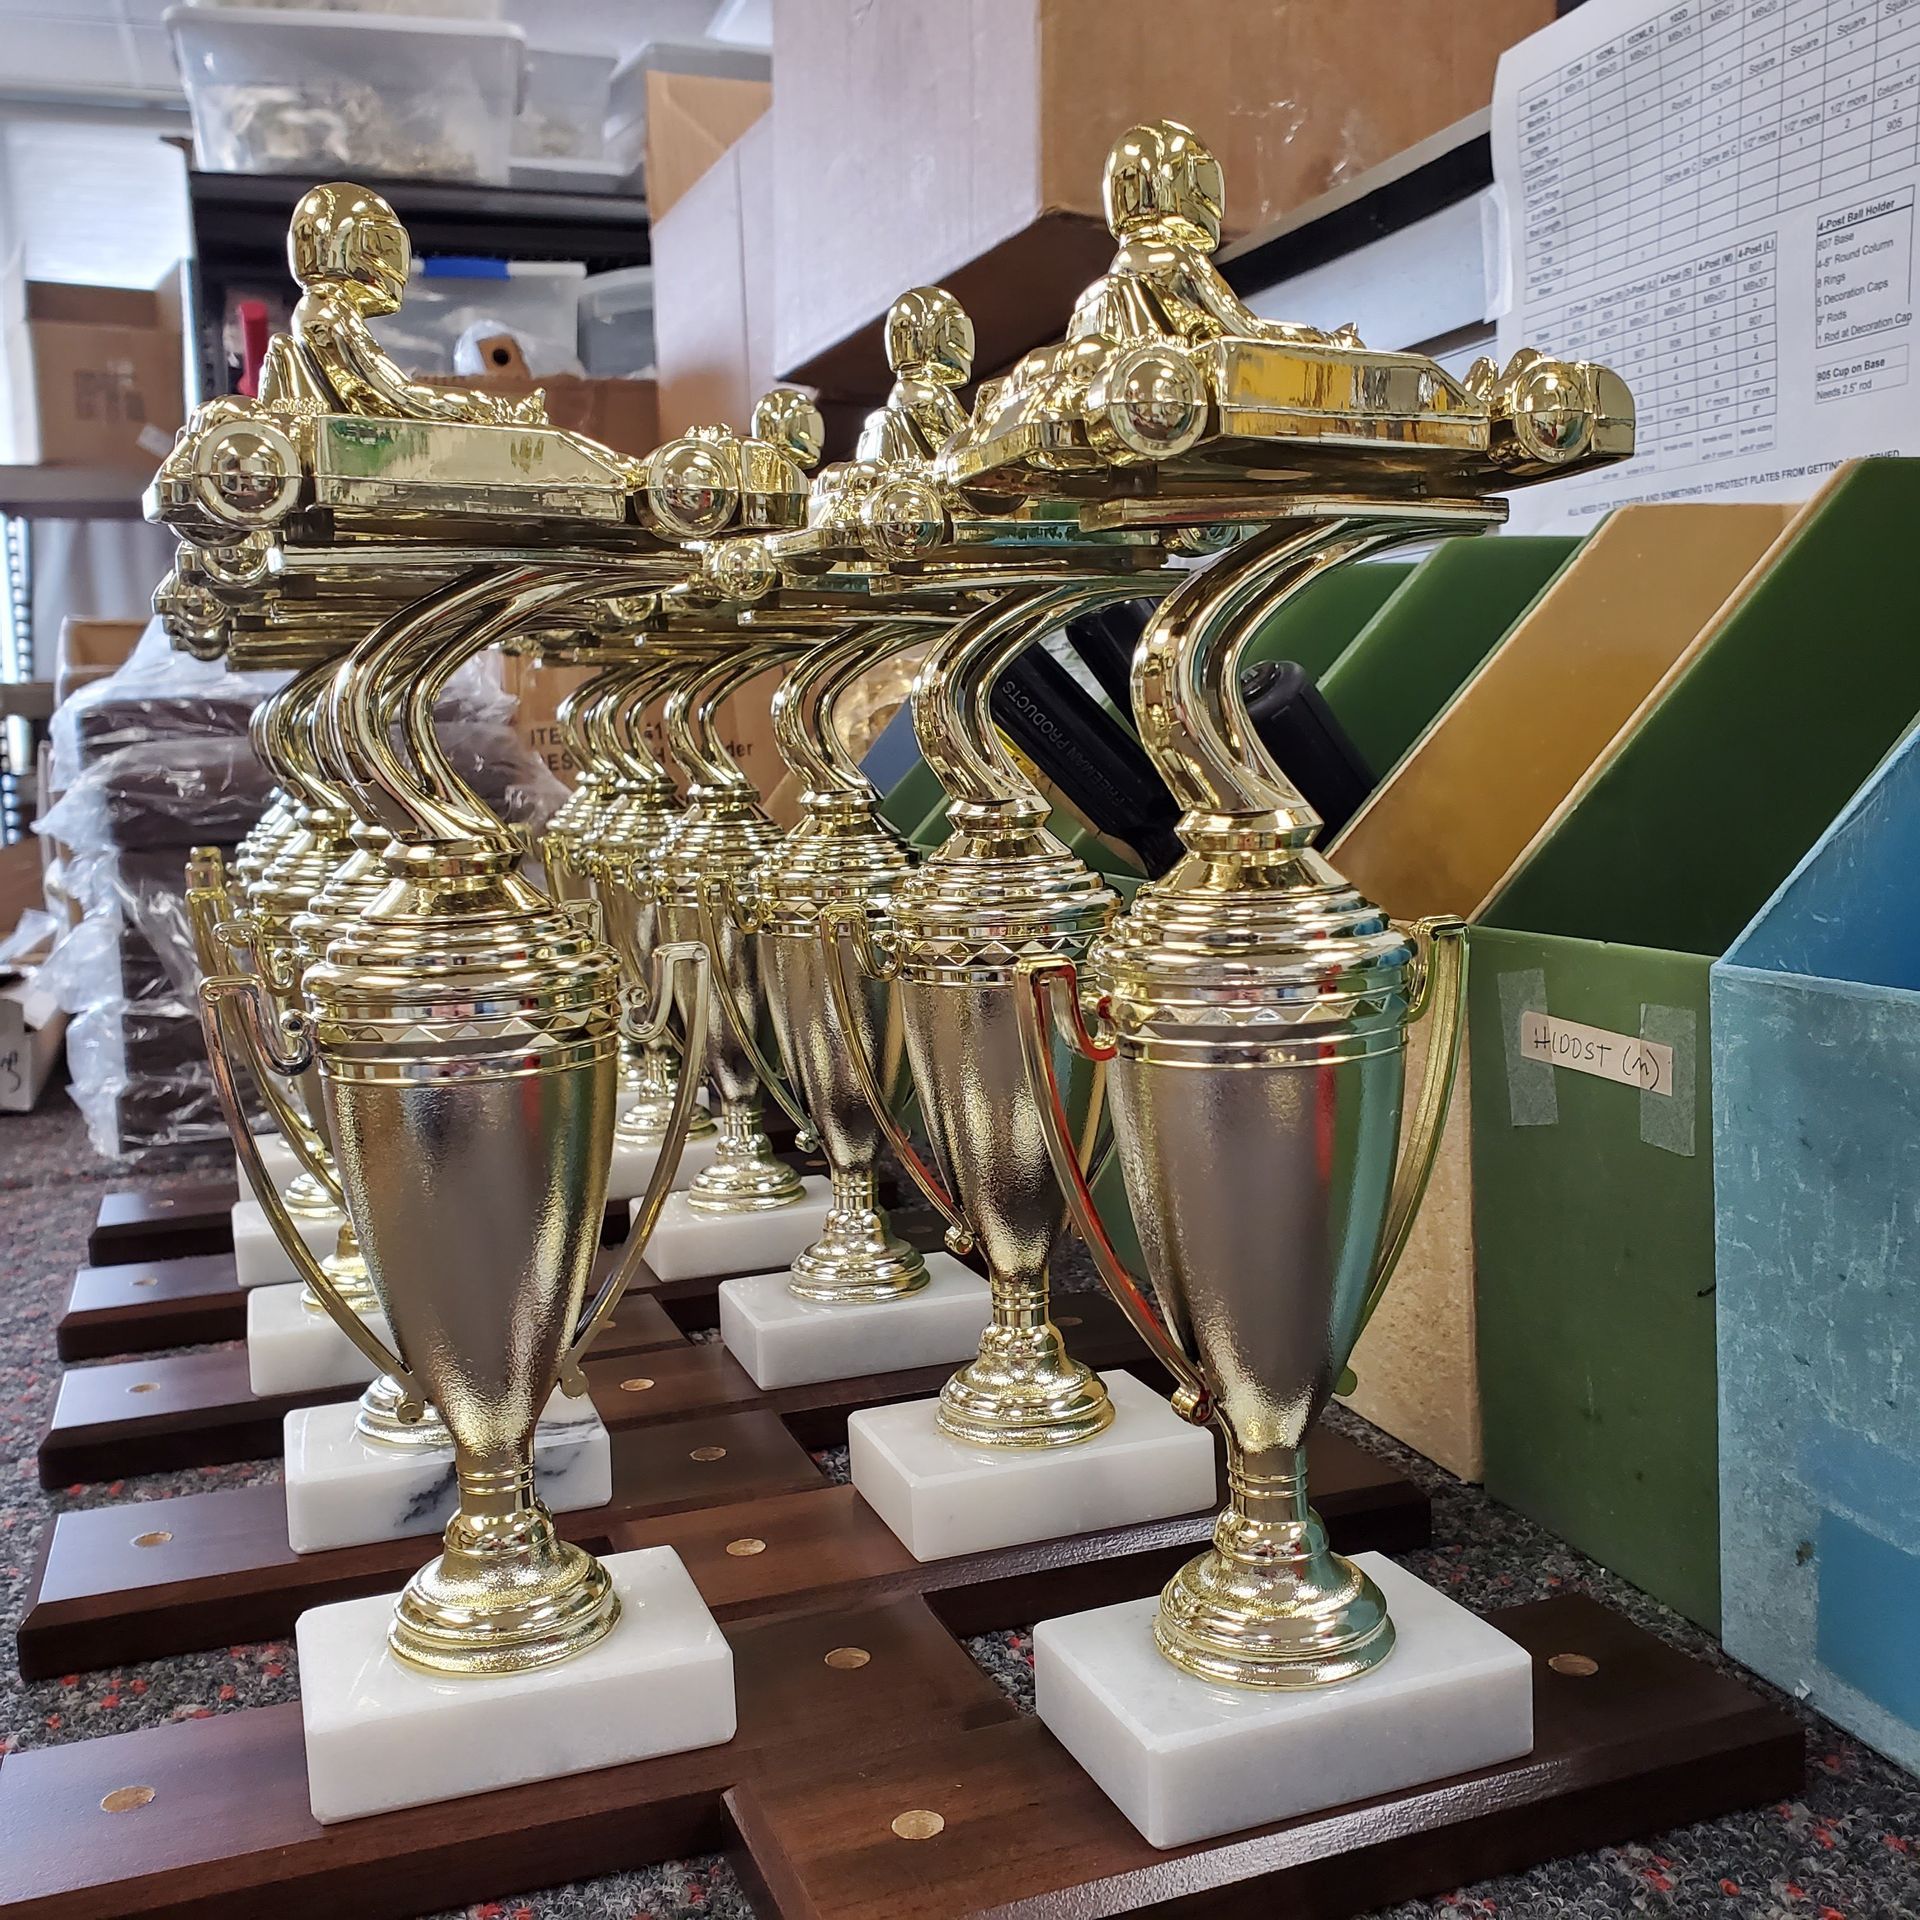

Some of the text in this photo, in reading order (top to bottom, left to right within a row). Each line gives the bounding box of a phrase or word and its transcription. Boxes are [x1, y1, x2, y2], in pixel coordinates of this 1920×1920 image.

[1837, 16, 1866, 36] Square
[1790, 38, 1819, 56] Square
[1749, 57, 1775, 75] Square
[1886, 117, 1903, 132] 905
[1817, 200, 1895, 231] 4-Post Ball Holder
[1738, 239, 1775, 258] 4-Post (L)
[1834, 232, 1854, 246] Base
[1834, 247, 1860, 264] Round
[1862, 239, 1894, 256] Column
[1823, 273, 1846, 286] Rings
[1823, 286, 1865, 305] Decoration
[1867, 280, 1888, 293] Caps
[1826, 311, 1847, 323] Rods
[1824, 330, 1840, 343] Rod
[1841, 328, 1849, 338] at
[1850, 316, 1893, 336] Decoration
[1895, 312, 1912, 324] Cap
[1833, 367, 1850, 378] Cup
[1851, 364, 1862, 374] on
[1864, 358, 1885, 370] Base
[1752, 387, 1770, 396] more
[1817, 387, 1841, 400] Needs
[1859, 379, 1872, 390] rod
[1661, 486, 1703, 501] SOMETHING
[1704, 484, 1713, 493] TO
[1715, 477, 1749, 491] PROTECT
[1750, 471, 1781, 484] PLATES
[1781, 466, 1806, 479] FROM
[1001, 680, 1070, 751] PRODUCTS
